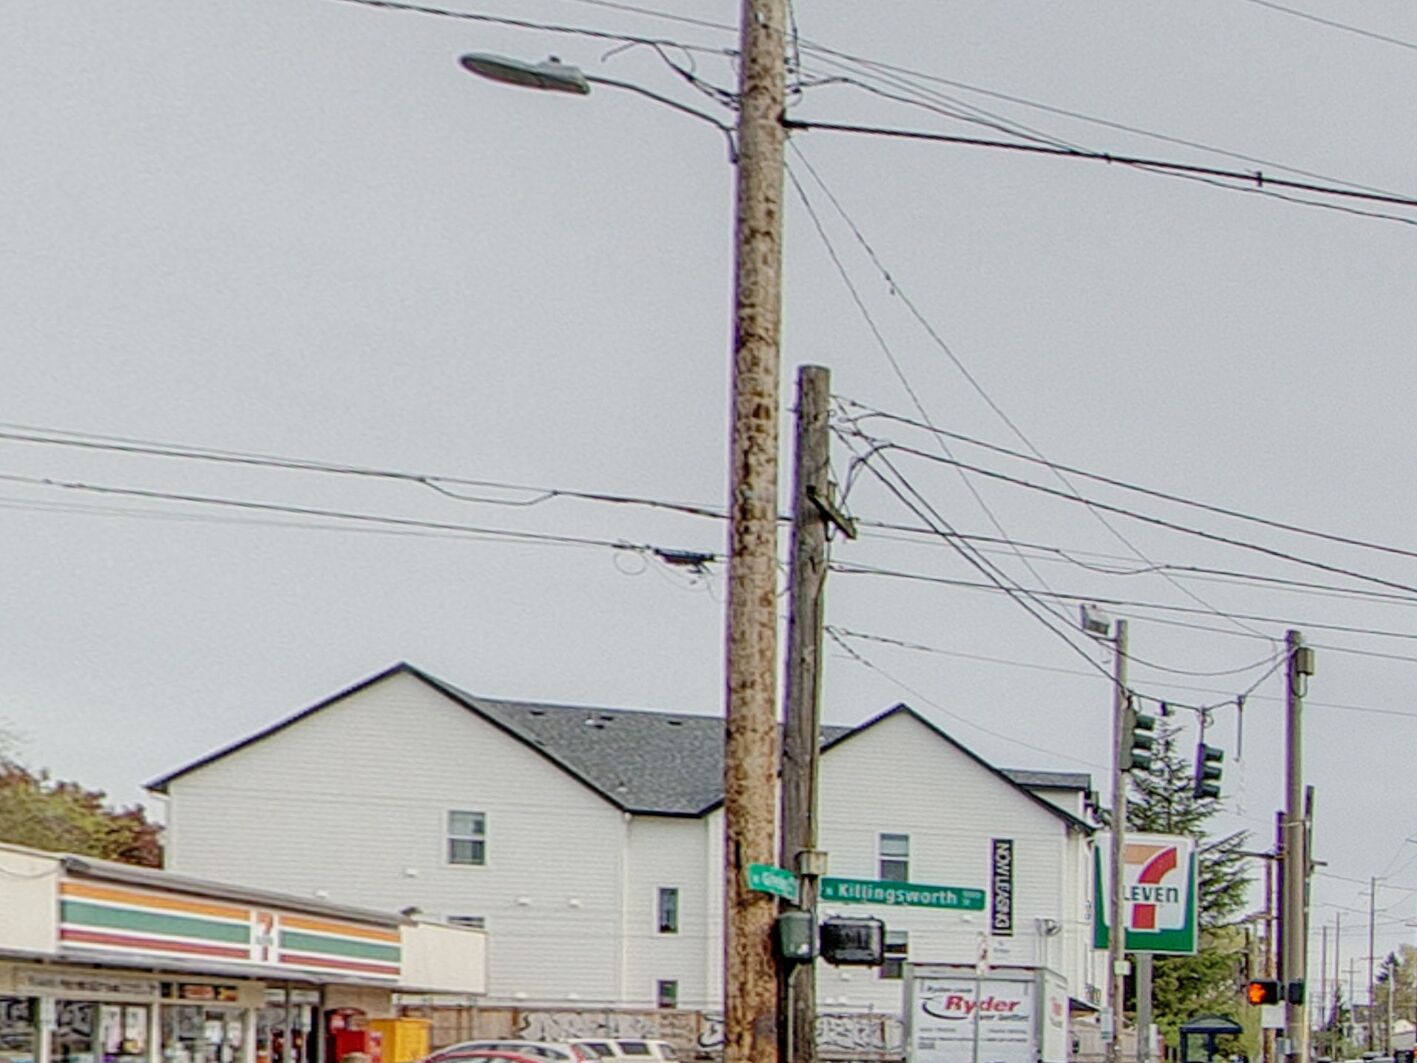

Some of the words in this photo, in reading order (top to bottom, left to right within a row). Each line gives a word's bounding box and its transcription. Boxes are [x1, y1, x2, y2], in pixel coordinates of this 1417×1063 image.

[995, 842, 1009, 876] NOW
[838, 883, 958, 905] Killingsworth
[994, 876, 1009, 928] LEASING
[1122, 885, 1179, 903] LEVEn
[944, 995, 1021, 1014] Ryder
